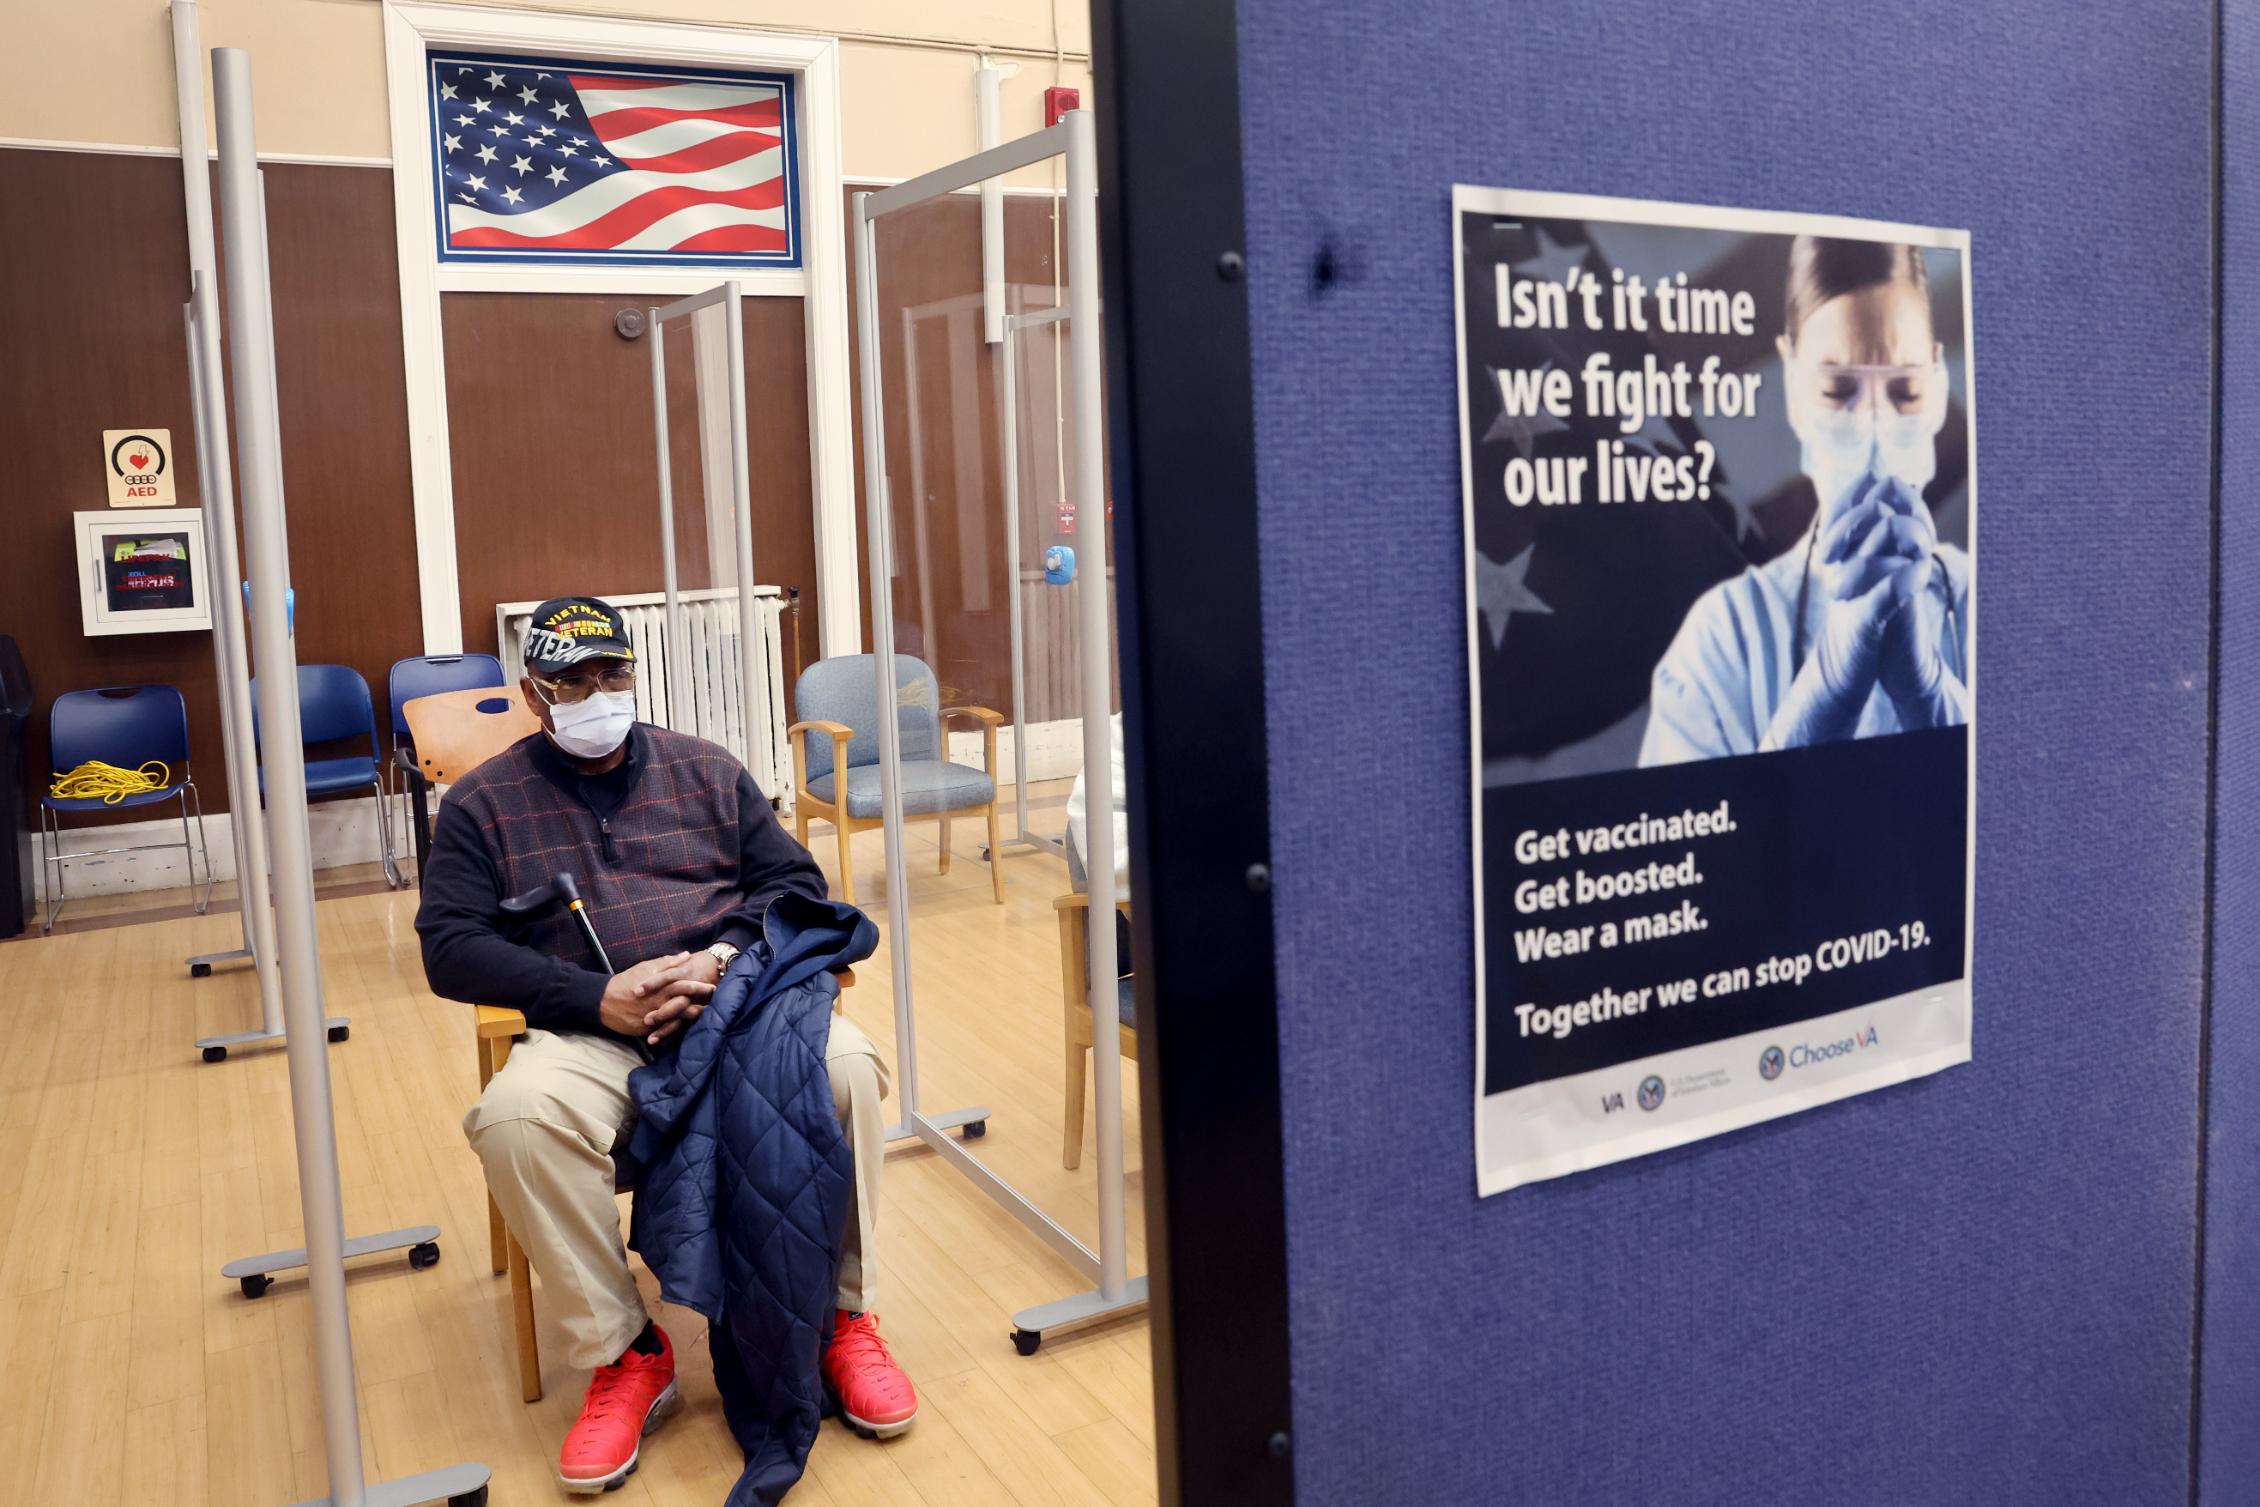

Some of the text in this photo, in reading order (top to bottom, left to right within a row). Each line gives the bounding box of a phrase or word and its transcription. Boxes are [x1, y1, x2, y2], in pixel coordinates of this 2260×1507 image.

[1494, 262, 1756, 336] Isn't it time
[1497, 352, 1762, 434] we fight for
[127, 486, 157, 497] AED
[1503, 439, 1716, 507] our lives?
[545, 605, 611, 625] VIETNAM
[555, 627, 613, 640] VETERAN
[1514, 800, 1737, 865] Get vaccinated.
[1514, 851, 1704, 914] Get boosted.
[1513, 899, 1709, 964] Wear a mask.
[1514, 920, 1932, 1039] Together we can stop COVID-19.
[1789, 1024, 1878, 1068] Choose VA
[1601, 1092, 1624, 1113] VA
